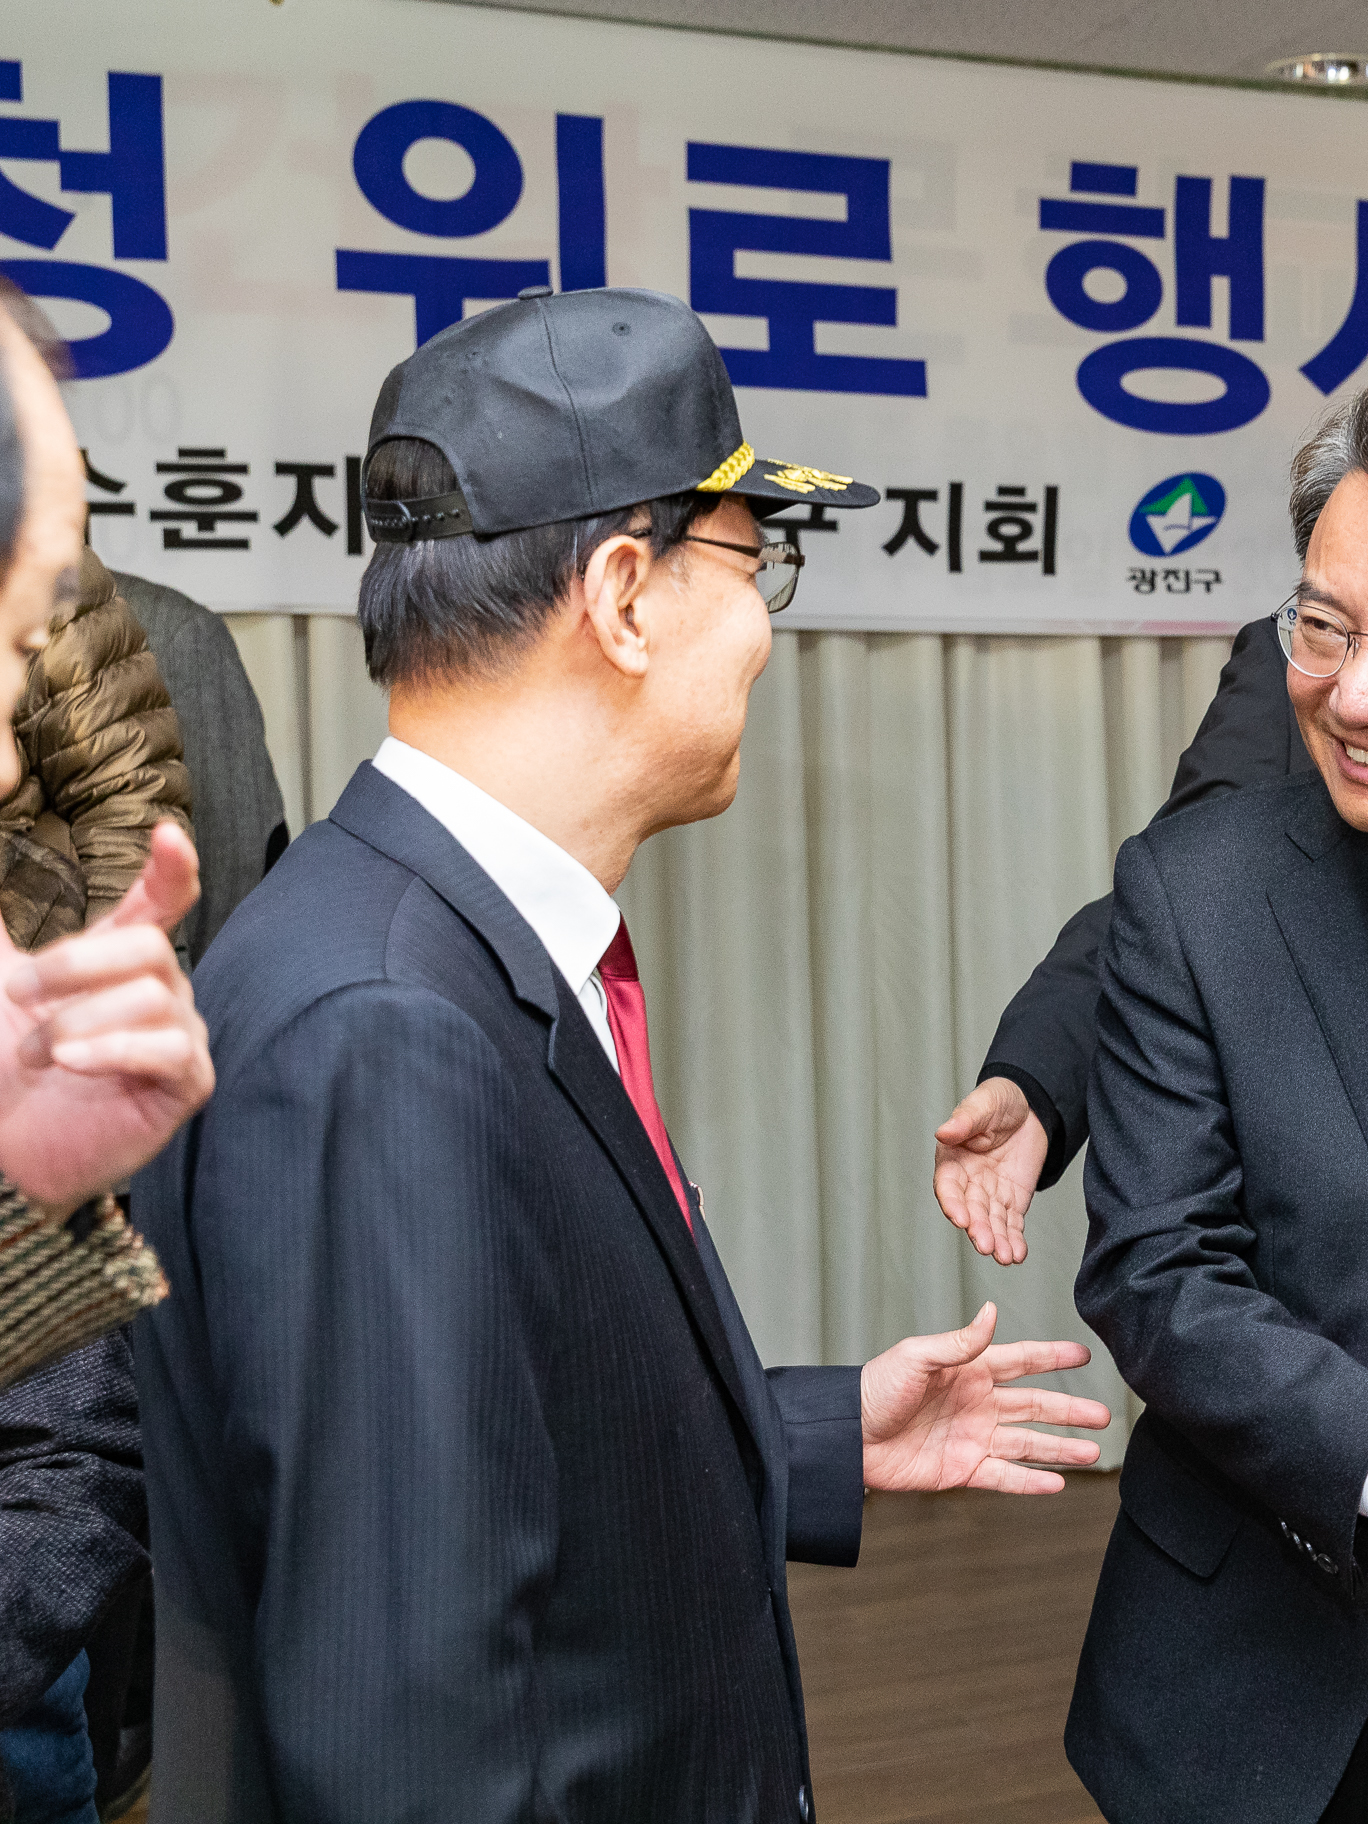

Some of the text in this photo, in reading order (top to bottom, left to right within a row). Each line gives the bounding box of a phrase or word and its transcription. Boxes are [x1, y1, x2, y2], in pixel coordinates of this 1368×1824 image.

[335, 99, 927, 399] 위로
[881, 481, 1060, 576] 지회
[1127, 567, 1222, 595] 광진구
